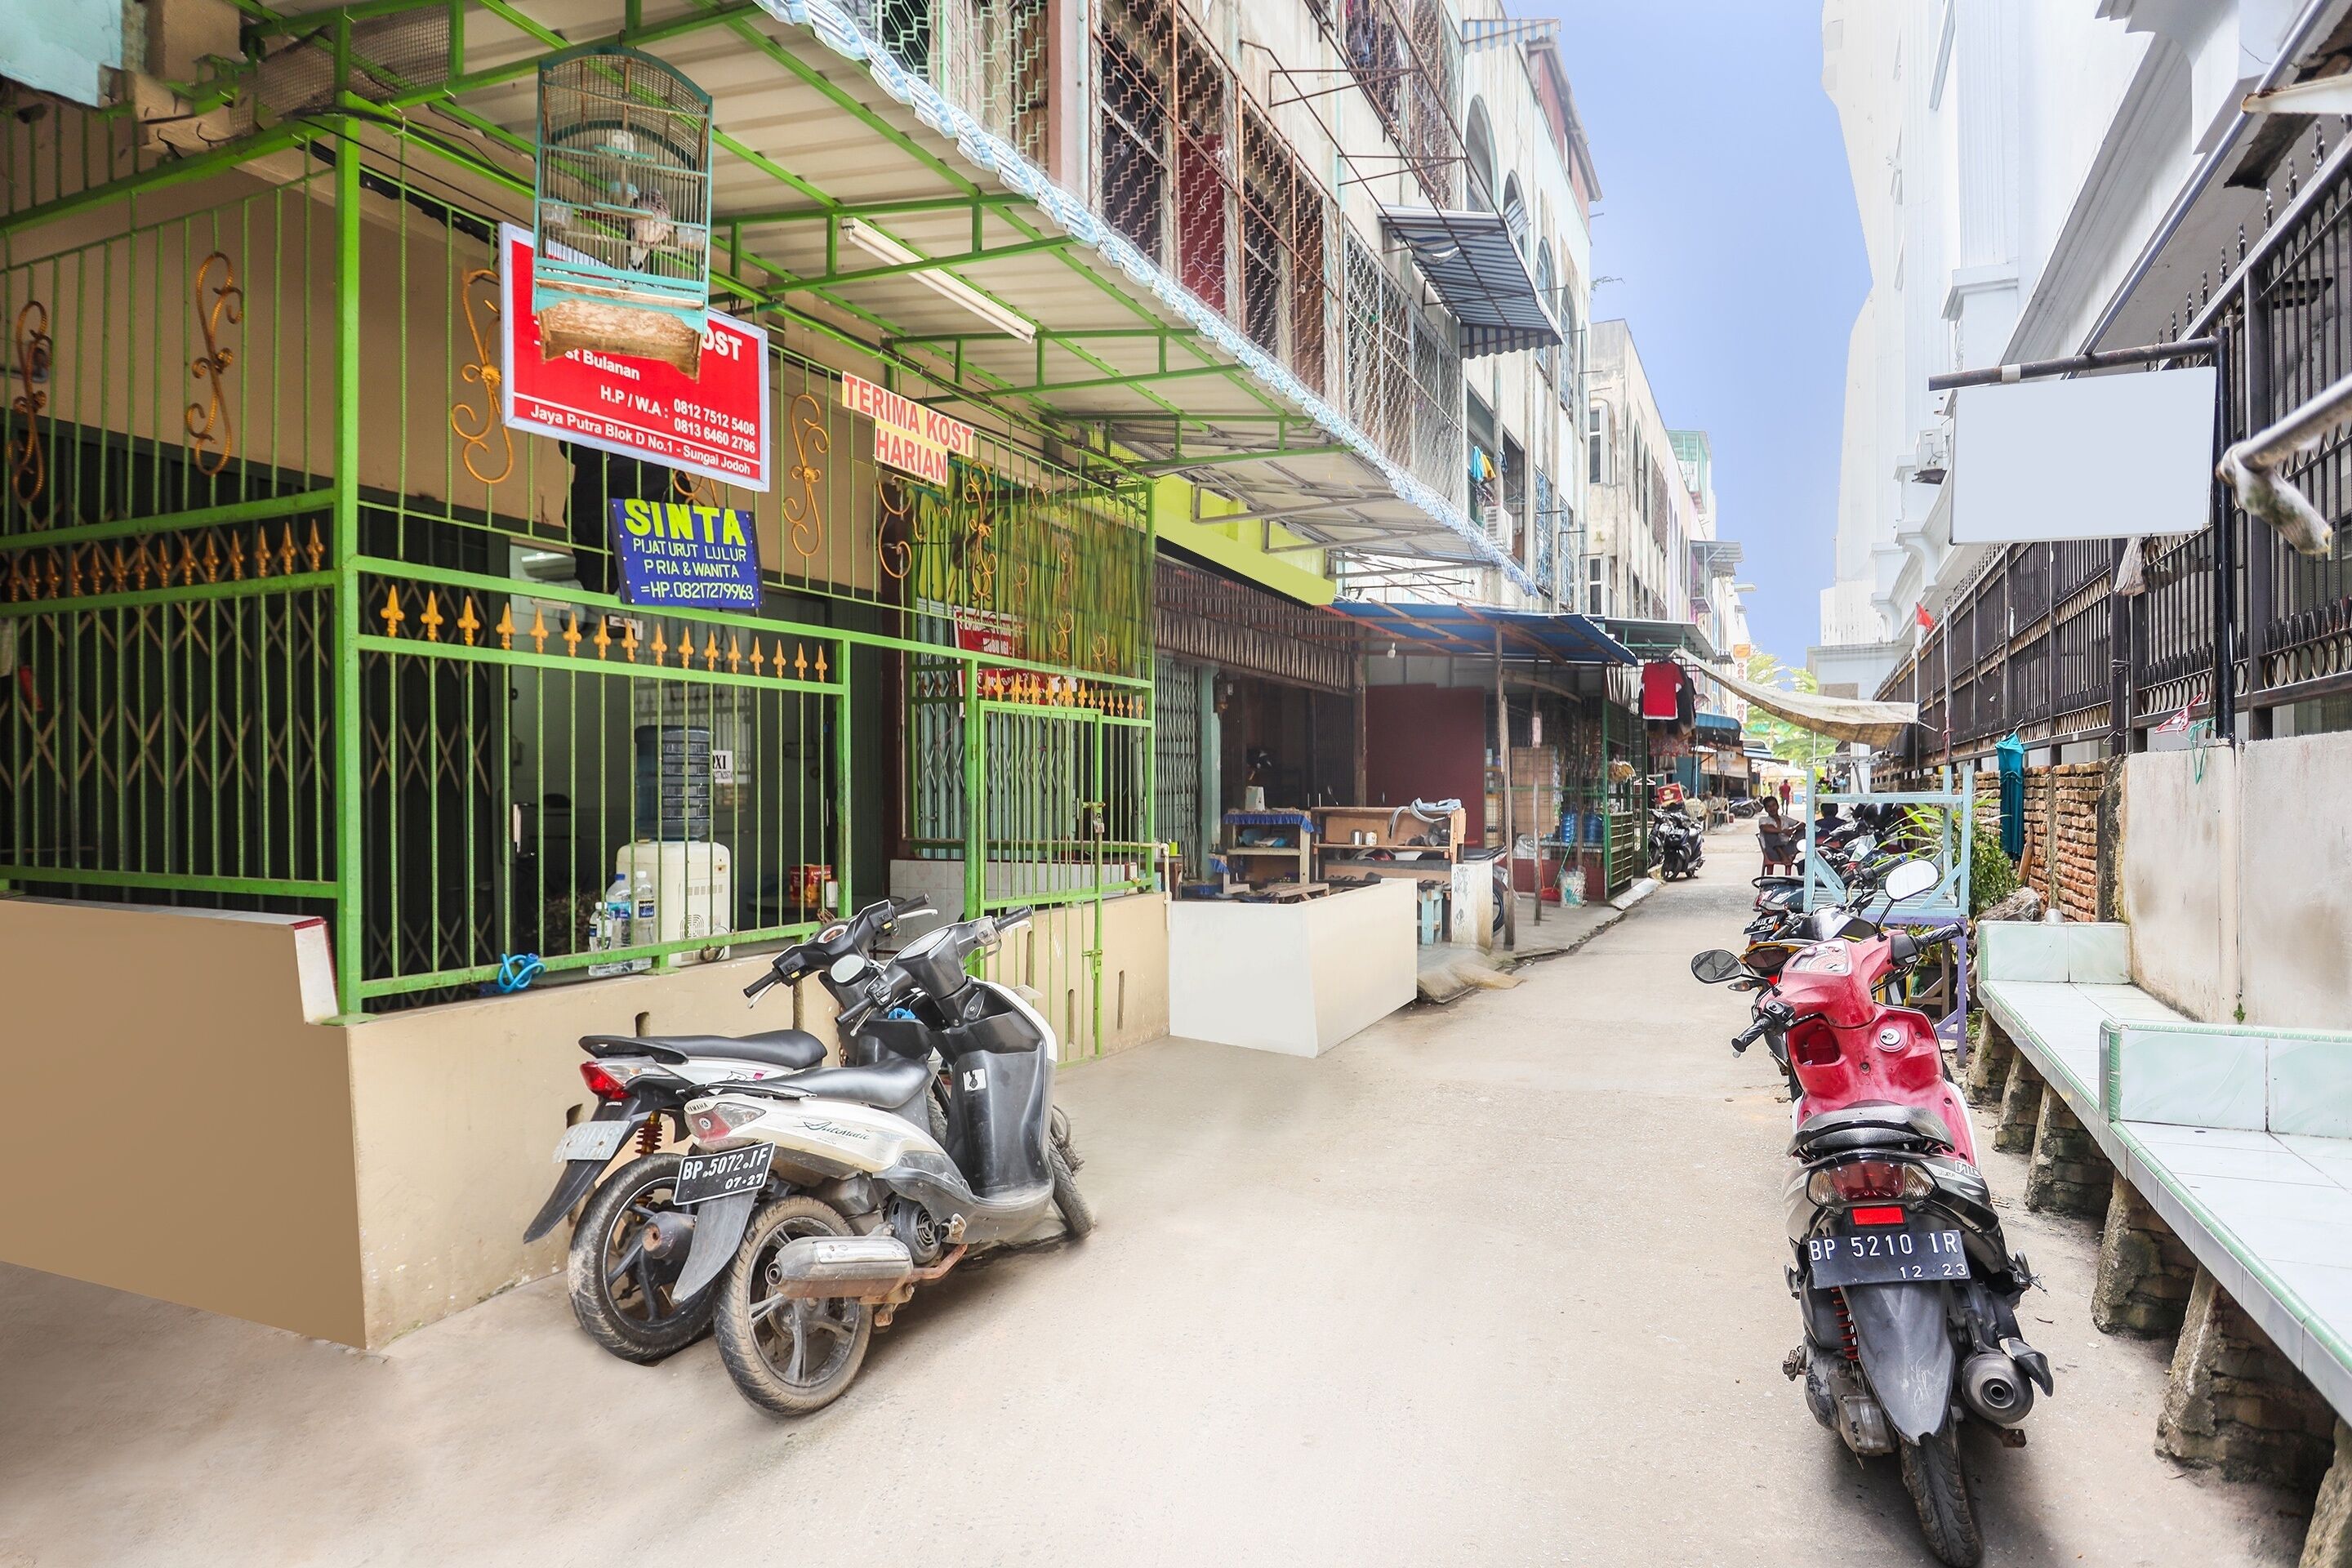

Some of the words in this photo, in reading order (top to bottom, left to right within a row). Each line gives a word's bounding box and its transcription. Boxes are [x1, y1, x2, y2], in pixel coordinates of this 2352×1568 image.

[702, 326, 743, 362] OST
[582, 349, 640, 381] Bulanan
[600, 385, 625, 402] H.P
[674, 399, 701, 420] 0812
[703, 407, 729, 428] 7512
[731, 416, 755, 437] 5408
[844, 375, 920, 434] TERIMA
[926, 410, 972, 455] KOST
[530, 403, 564, 425] Jaya
[567, 412, 602, 434] Putra
[605, 423, 633, 443] Blok
[635, 432, 646, 445] D
[648, 436, 673, 453] No.1
[683, 446, 719, 466] Sungai
[720, 456, 751, 475] Jodoh
[674, 417, 702, 439] 0813
[703, 426, 729, 447] 6460
[731, 434, 755, 454] 2796
[876, 428, 947, 483] HARIAN
[624, 498, 747, 547] SINTA
[633, 537, 666, 554] PIJAT
[668, 541, 698, 558] URUT
[704, 546, 746, 562] LULUR
[644, 559, 680, 575] PRIA
[682, 561, 691, 576] &
[692, 562, 740, 578] WANITA
[1809, 1238, 1836, 1261] BP
[1851, 1233, 1913, 1258] 5210
[1929, 1232, 1958, 1254] IR
